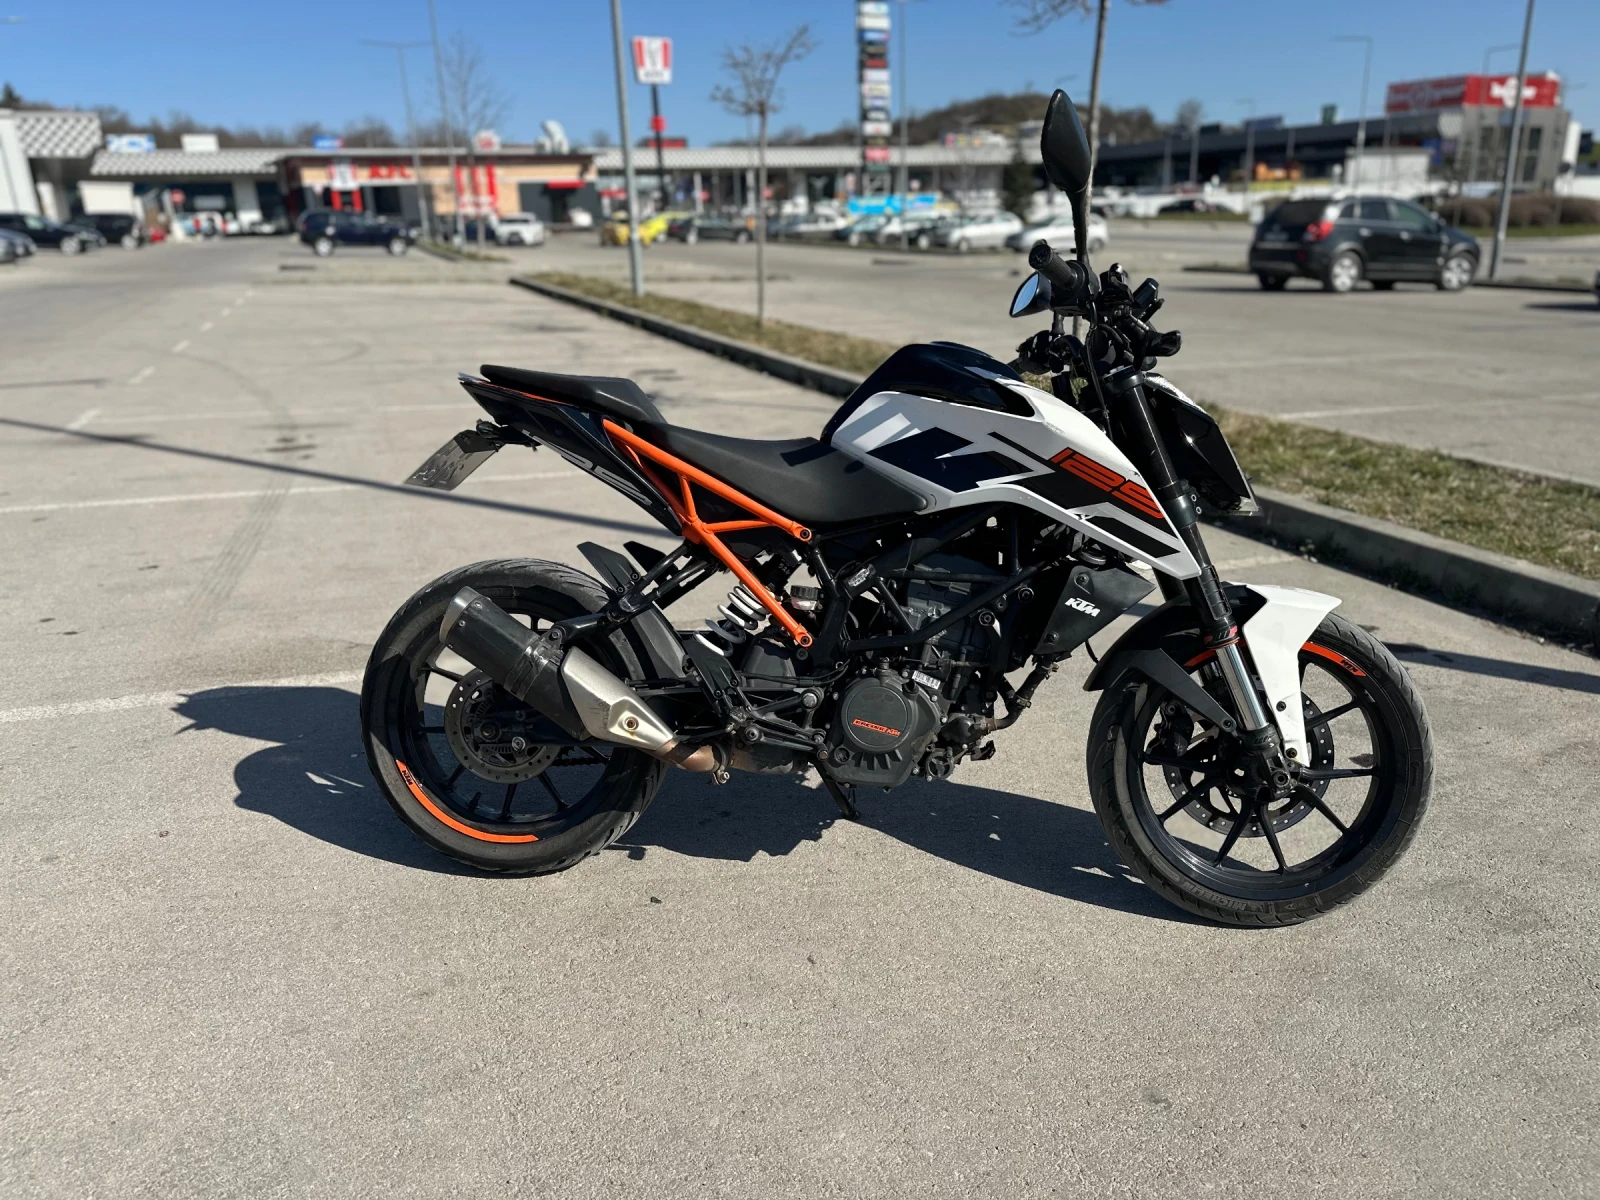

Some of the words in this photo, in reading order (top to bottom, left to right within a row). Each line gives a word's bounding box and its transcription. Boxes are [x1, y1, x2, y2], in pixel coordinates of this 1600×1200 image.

[1051, 447, 1164, 520] 125
[1065, 597, 1101, 617] KTM
[1181, 880, 1246, 911] MICHELIN
